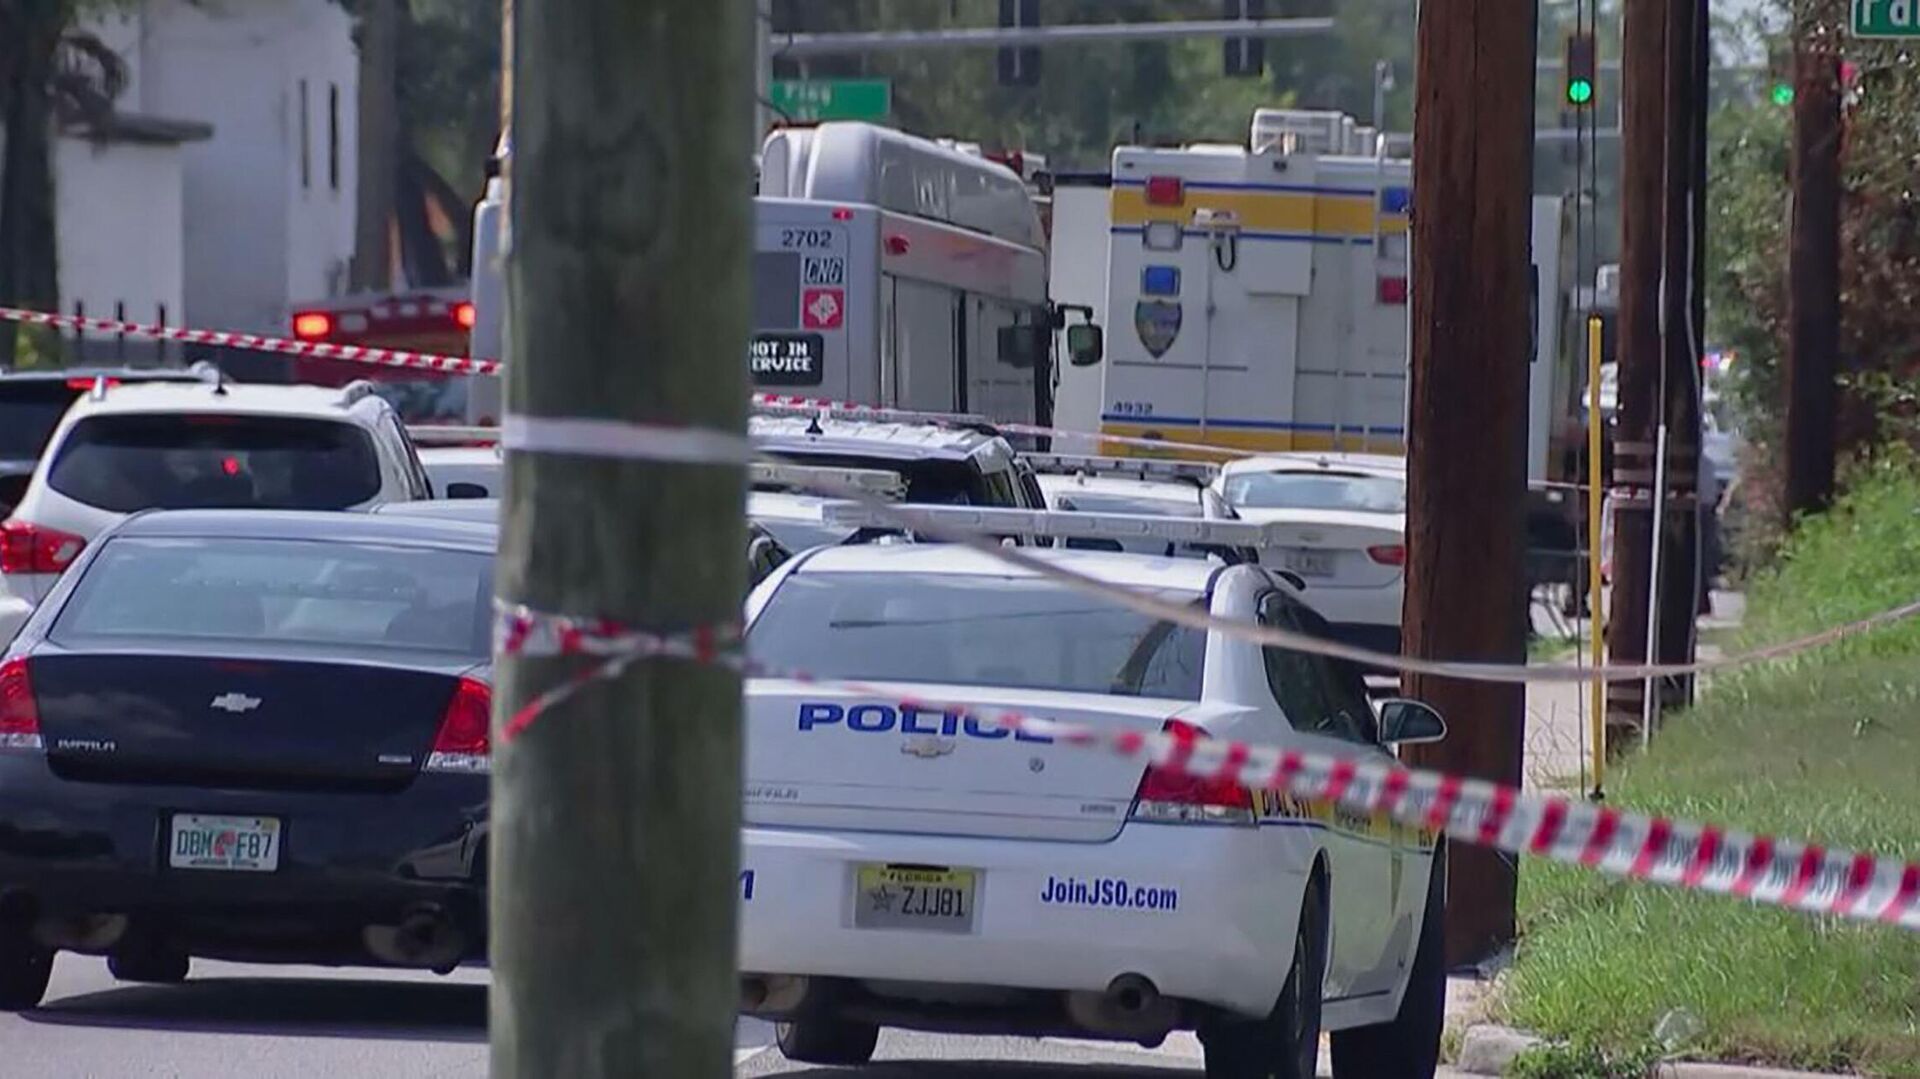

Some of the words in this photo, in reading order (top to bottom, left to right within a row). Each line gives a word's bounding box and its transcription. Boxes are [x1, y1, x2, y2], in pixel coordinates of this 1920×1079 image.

[782, 229, 833, 248] 2702
[805, 258, 843, 284] CNG
[789, 341, 807, 356] IN
[751, 357, 812, 372] ERVICE
[177, 830, 213, 857] DBM
[235, 832, 273, 859] F87
[902, 886, 965, 917] ZJJ81
[1041, 876, 1177, 911] JoinJSO.com
